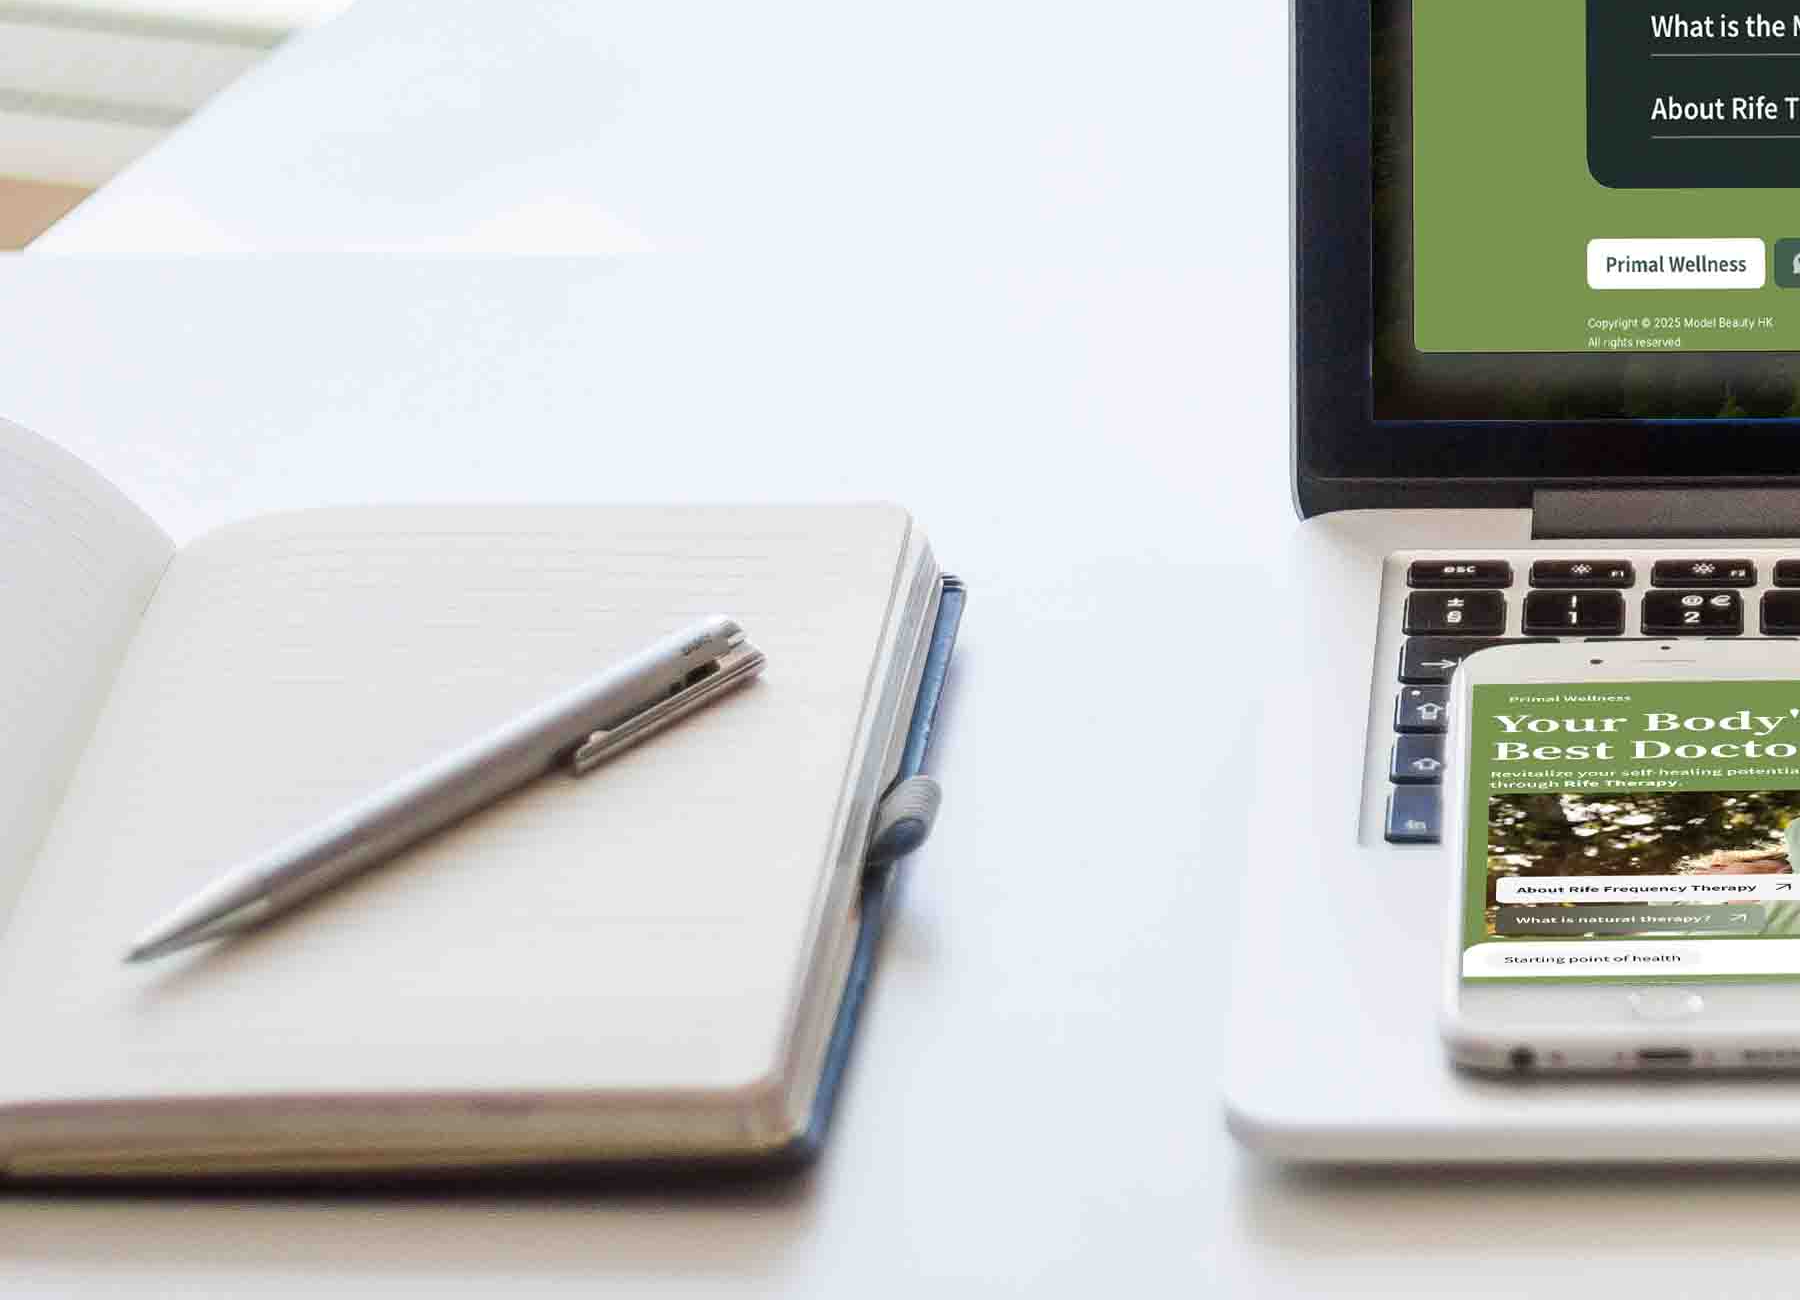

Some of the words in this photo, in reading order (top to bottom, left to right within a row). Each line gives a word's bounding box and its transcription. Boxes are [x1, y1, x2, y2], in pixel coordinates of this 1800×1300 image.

[1650, 13, 1715, 38] What
[1720, 13, 1739, 38] is
[1744, 13, 1786, 38] the
[1650, 95, 1725, 120] About
[1732, 95, 1778, 120] Rife
[1606, 255, 1665, 273] Primal
[1668, 254, 1747, 273] Wellness
[1587, 317, 1638, 332] Copyright
[1654, 316, 1681, 329] 2025
[1683, 317, 1717, 329] Model
[1718, 316, 1755, 331] Beauty
[1757, 316, 1774, 328] HK
[1587, 336, 1601, 348] All
[1603, 336, 1633, 350] rights
[1635, 336, 1681, 348] reserved
[1443, 564, 1476, 575] esc
[1568, 611, 1578, 624] 1
[1684, 611, 1700, 624] 2
[1509, 694, 1560, 703] Primal
[1563, 694, 1631, 703] Wellness
[1492, 714, 1628, 733] Your
[1492, 741, 1615, 761] Best
[1491, 769, 1574, 779] Revitalize
[1577, 771, 1615, 779] your
[1621, 767, 1723, 777] self-healing
[1488, 779, 1560, 790] through
[1563, 779, 1600, 788] Rife
[1517, 886, 1565, 894] About
[1691, 884, 1757, 893] Therapy
[1516, 916, 1557, 925] What
[1578, 915, 1636, 924] natural
[1639, 913, 1713, 925] therapy?
[1504, 956, 1566, 965] Starting
[1569, 956, 1608, 964] point
[1613, 955, 1628, 963] of
